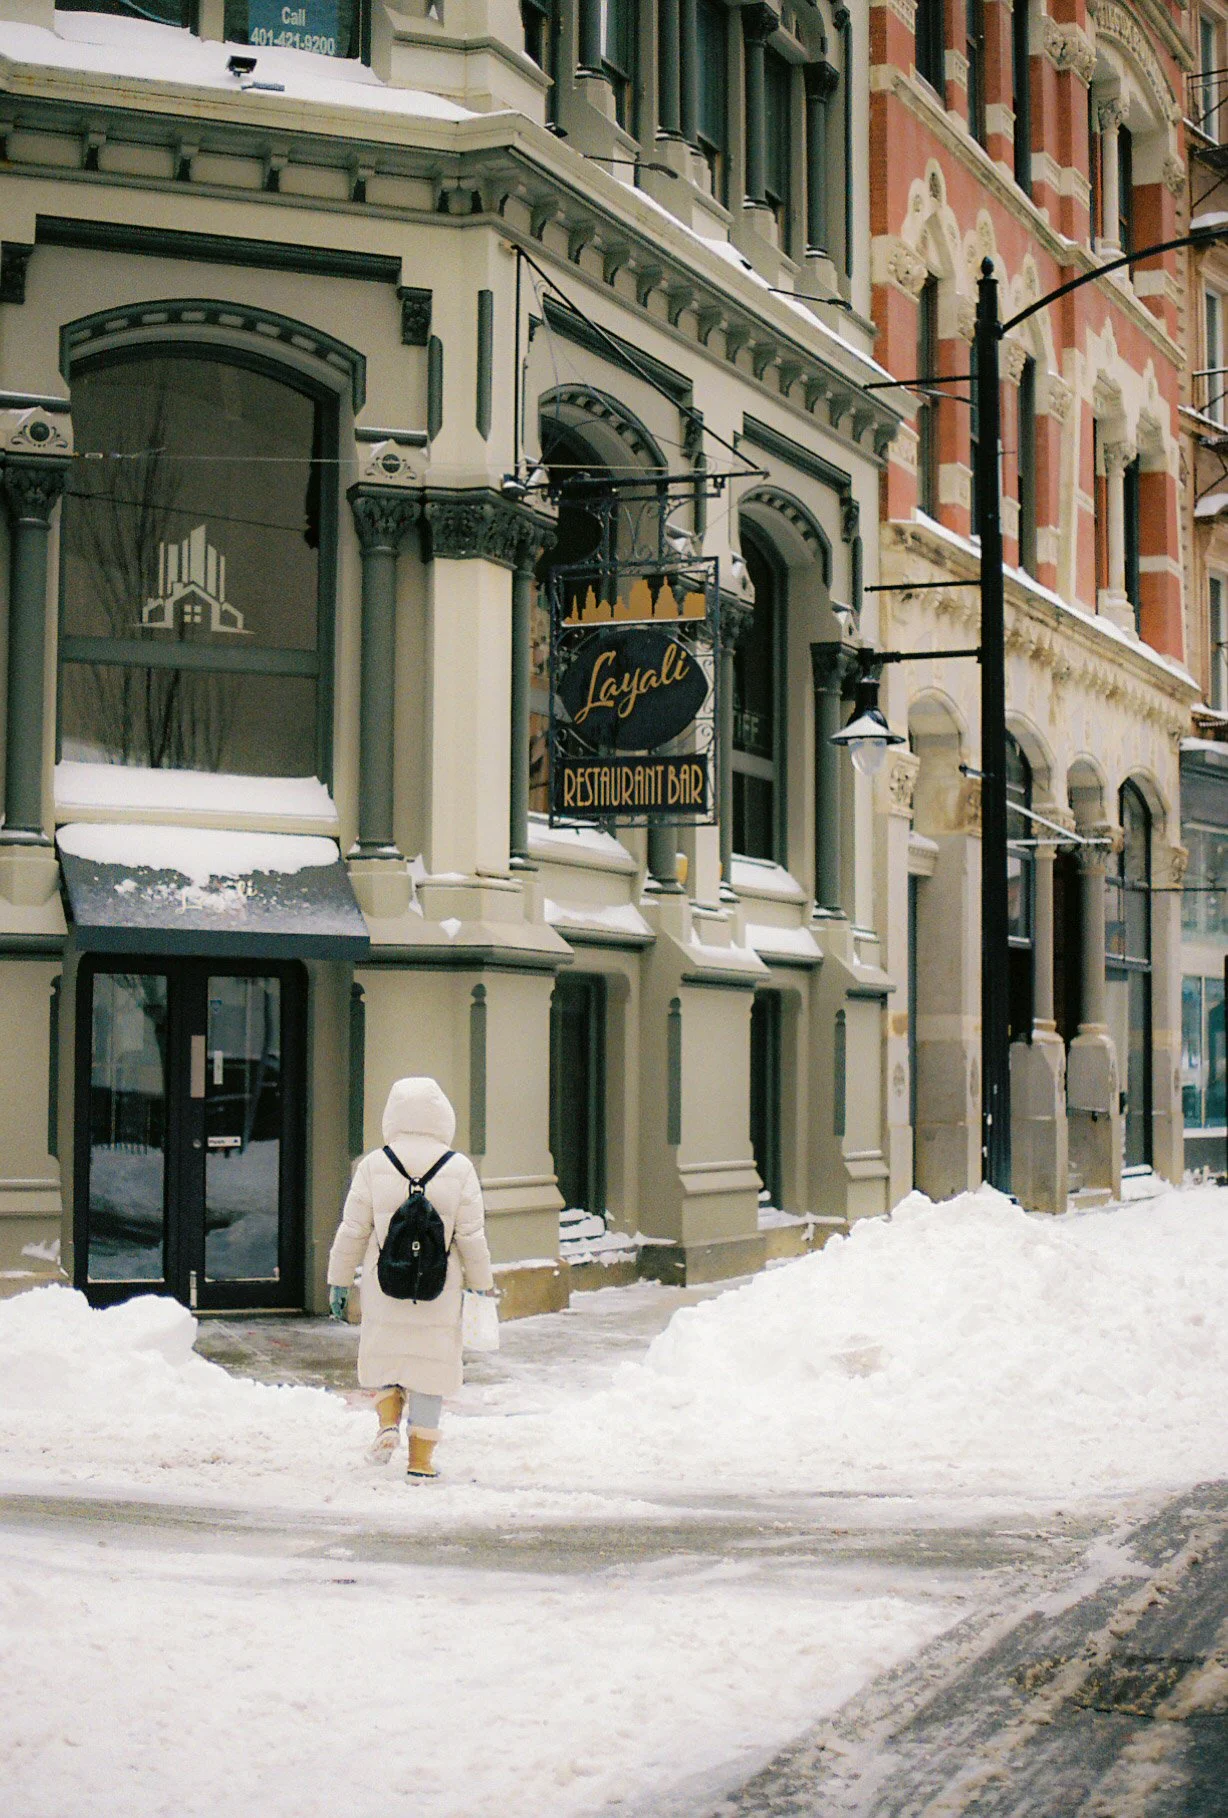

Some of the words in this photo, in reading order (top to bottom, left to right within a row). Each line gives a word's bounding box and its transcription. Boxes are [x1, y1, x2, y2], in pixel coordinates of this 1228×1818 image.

[282, 7, 306, 26] Call
[251, 27, 335, 55] 401-421-9200
[575, 643, 690, 724] Layali
[563, 765, 665, 808] RESTAURANT
[667, 763, 704, 805] BAR
